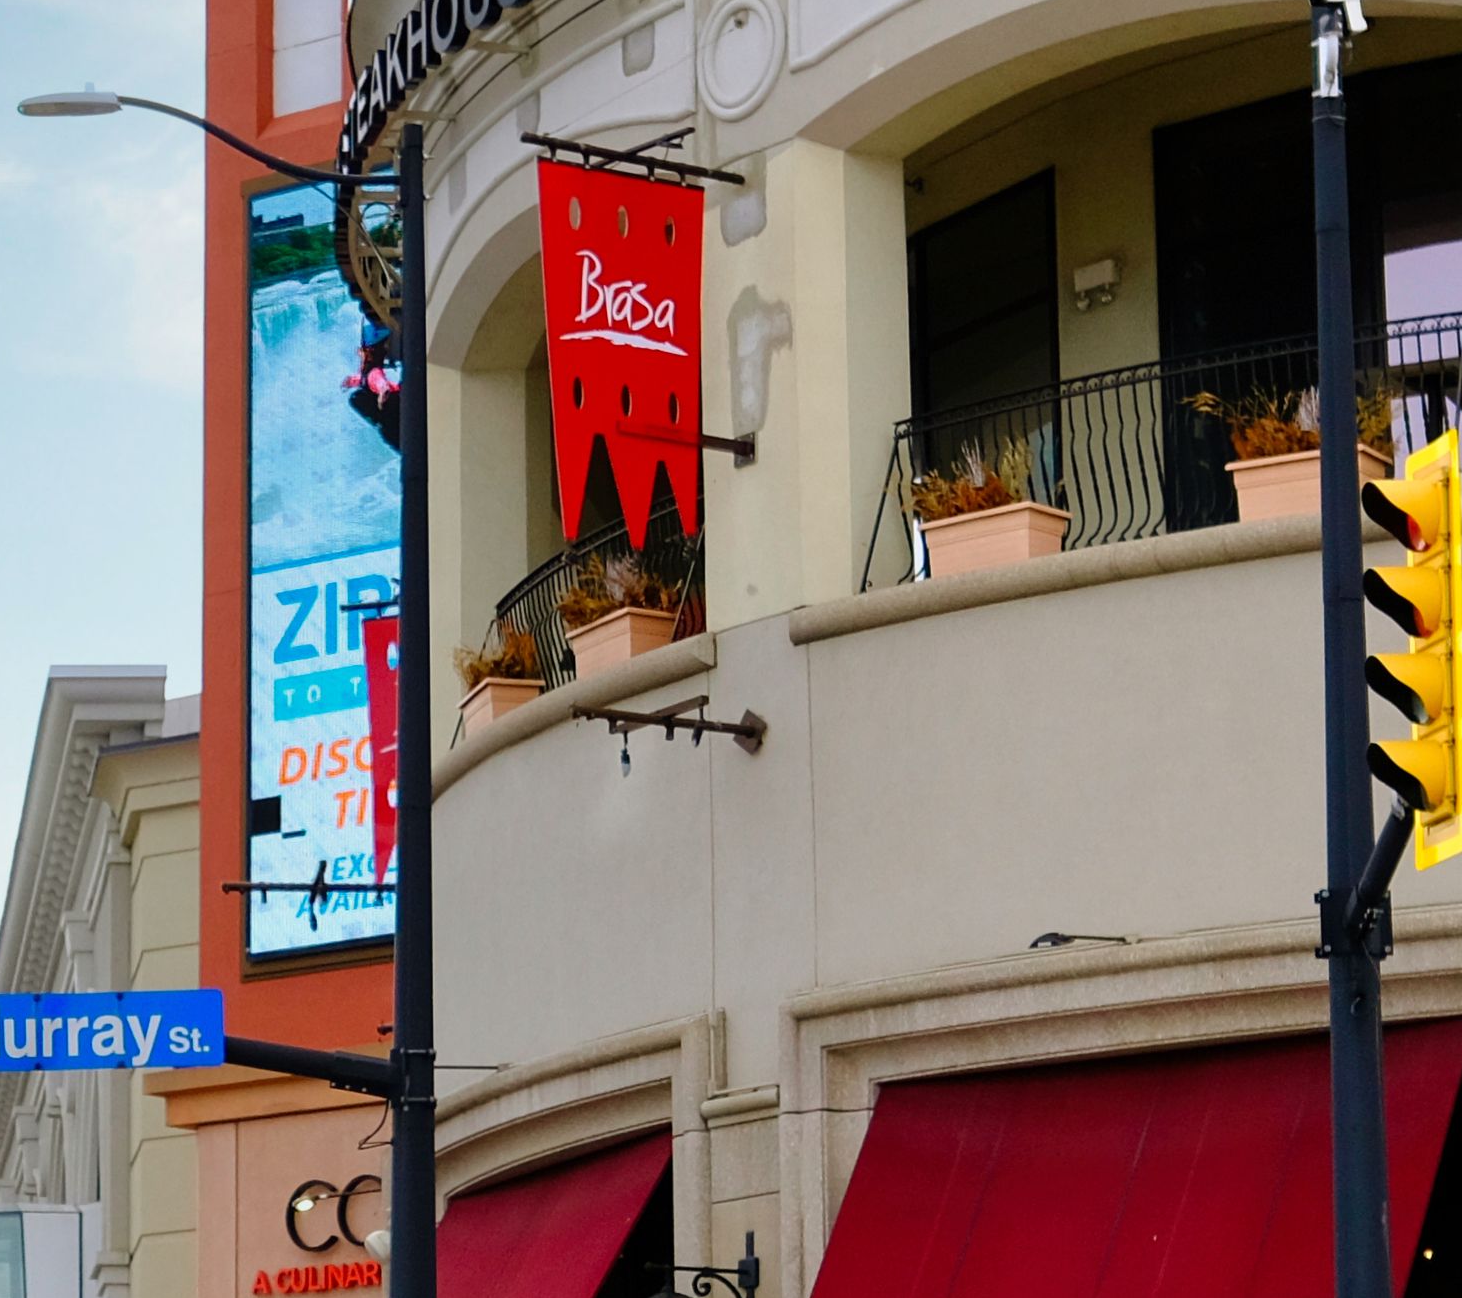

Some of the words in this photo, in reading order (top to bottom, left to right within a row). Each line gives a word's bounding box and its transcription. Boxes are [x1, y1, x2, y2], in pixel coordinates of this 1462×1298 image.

[574, 249, 676, 338] Brasa
[283, 684, 322, 708] TO
[349, 676, 363, 697] T
[278, 736, 374, 787] DISC
[334, 787, 369, 829] TI
[168, 1026, 210, 1054] St.
[252, 1270, 272, 1295] A
